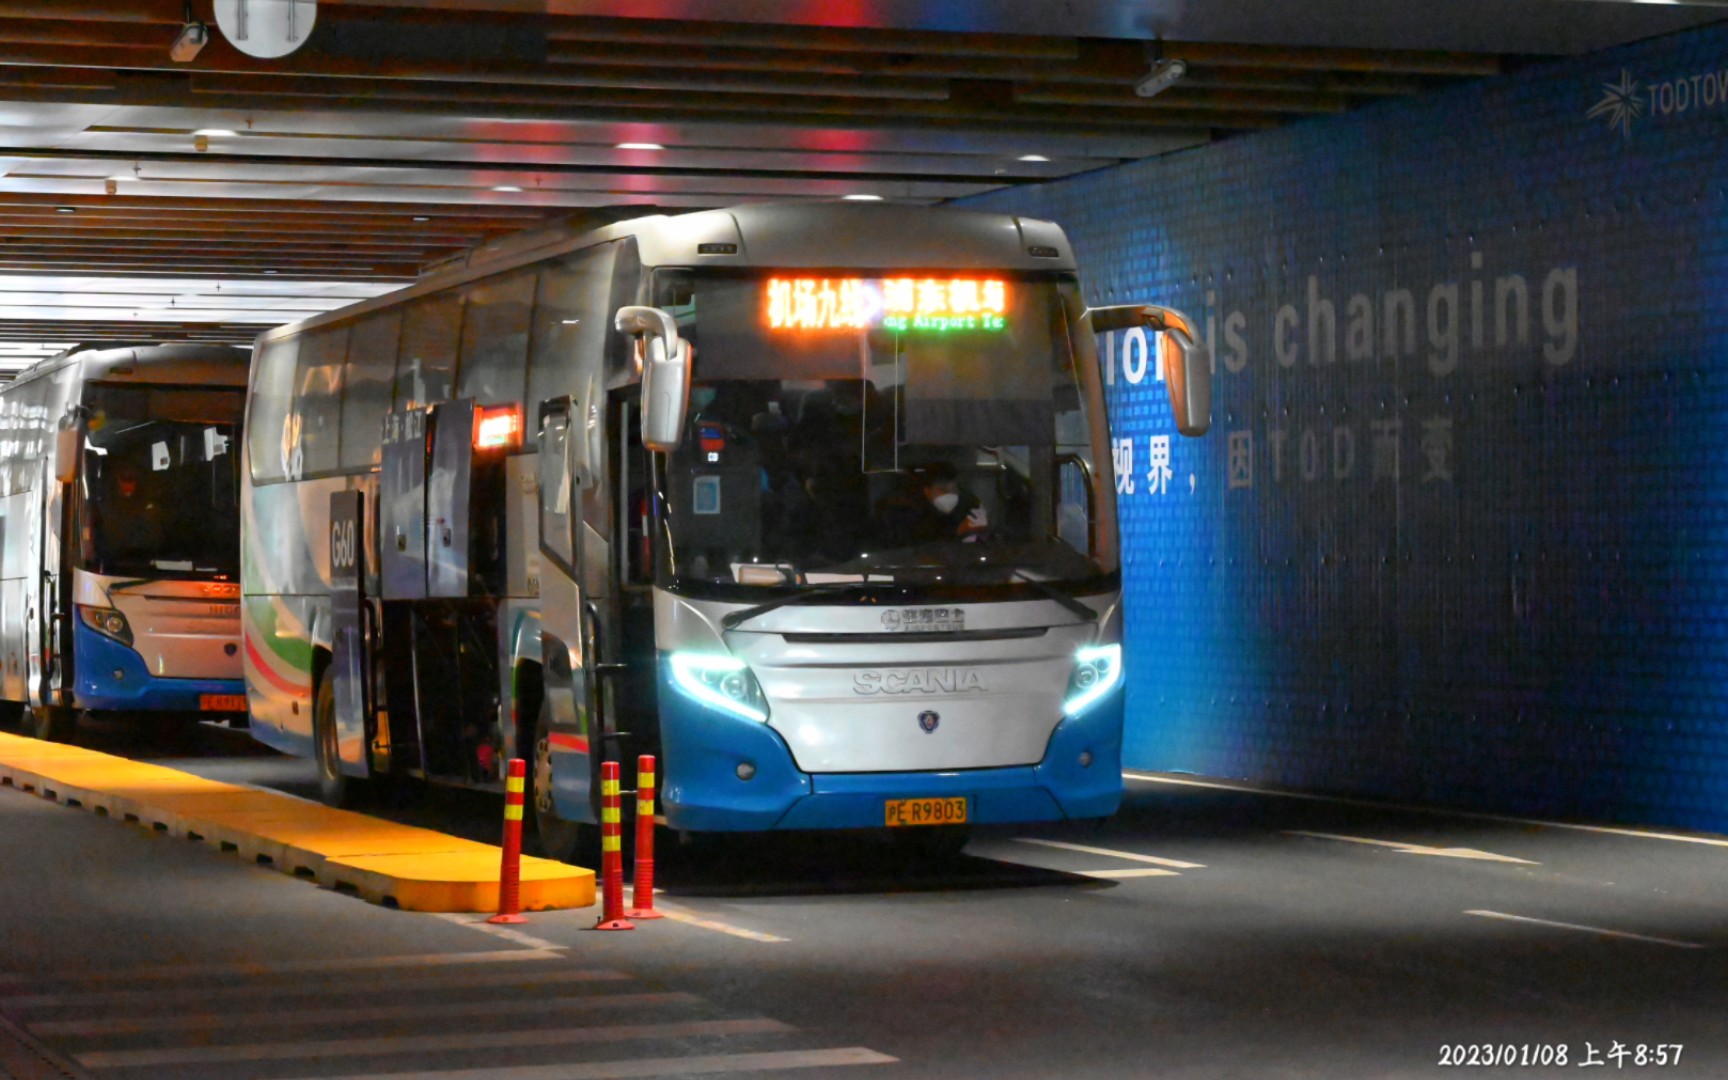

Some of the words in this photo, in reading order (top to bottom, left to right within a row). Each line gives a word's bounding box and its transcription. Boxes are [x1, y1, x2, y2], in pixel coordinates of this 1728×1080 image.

[913, 314, 975, 331] Airport
[1207, 290, 1247, 374] is
[1273, 251, 1578, 376] changing
[332, 520, 354, 568] G60
[853, 668, 989, 695] SCANIA
